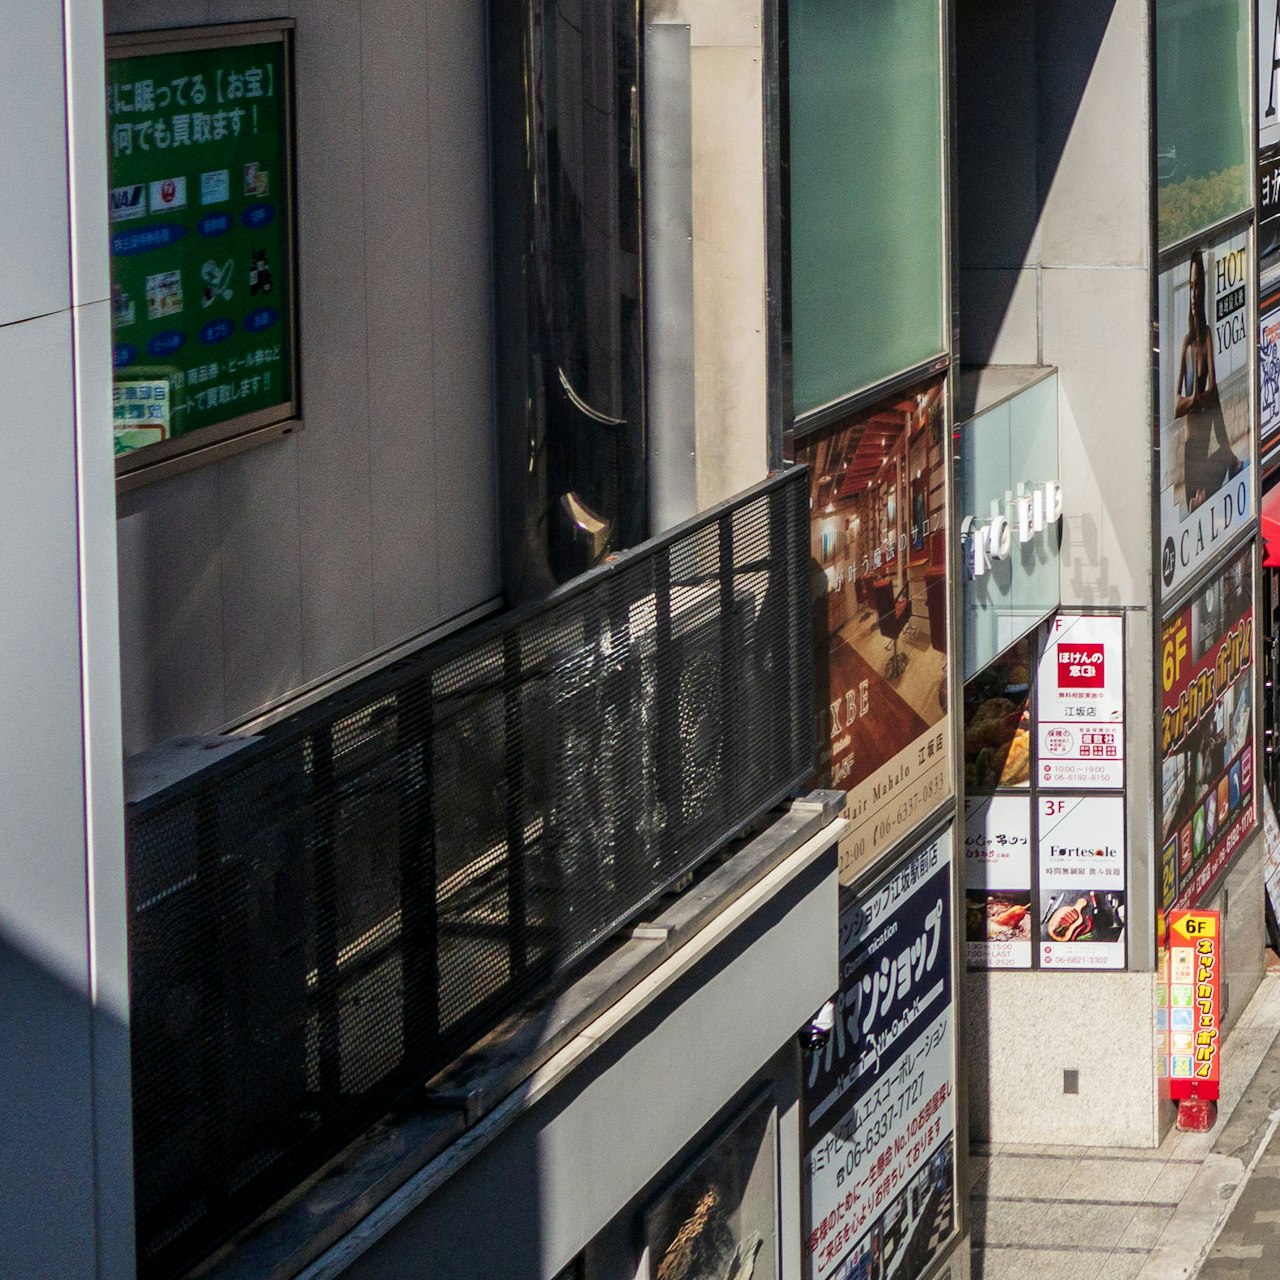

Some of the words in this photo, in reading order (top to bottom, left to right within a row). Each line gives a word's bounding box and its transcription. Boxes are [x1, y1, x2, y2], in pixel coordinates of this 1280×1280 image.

[1216, 248, 1246, 294] HOT
[1217, 314, 1246, 356] YOGA
[1163, 545, 1175, 577] 2F
[1181, 480, 1246, 567] CALDO
[1059, 652, 1103, 665] ほけんの
[1162, 628, 1187, 672] 6F
[1216, 618, 1253, 697] ポパイ
[1069, 666, 1096, 677] 窓口
[1064, 706, 1097, 718] 江坂店
[842, 796, 868, 824] Hair
[872, 765, 911, 805] Mahalo
[917, 733, 945, 766] 江坂店
[1055, 774, 1110, 782] 06-6192-8150
[1045, 800, 1065, 816] 3F
[1046, 868, 1085, 876] 時間無制限
[1089, 868, 1121, 876] 飲み放題
[1186, 919, 1206, 934] 6F
[845, 1072, 925, 1170] 06-6337-7727
